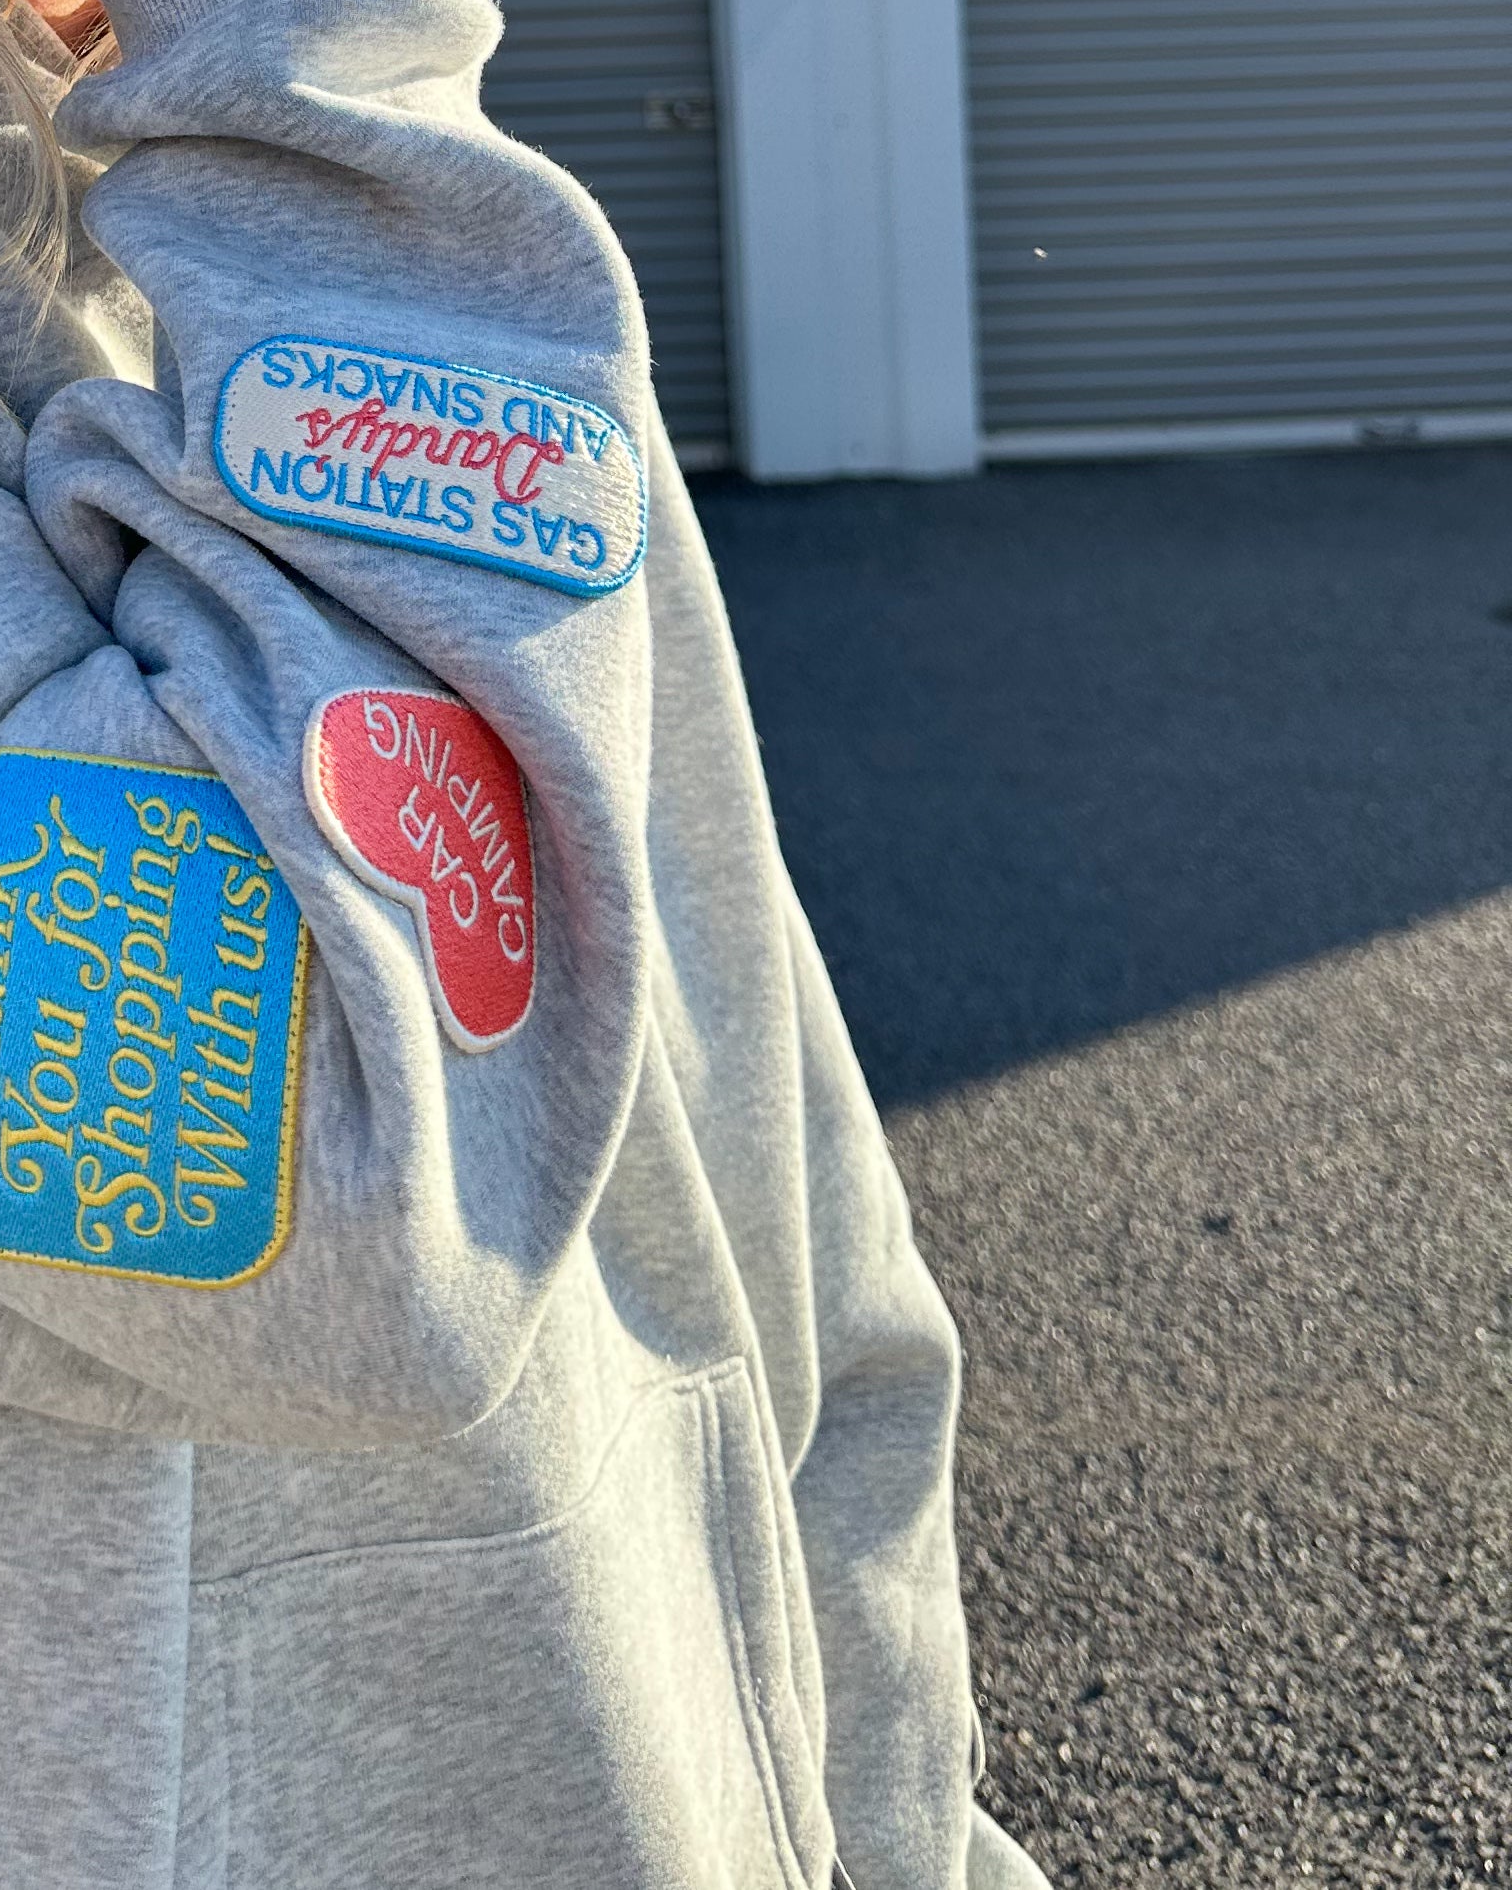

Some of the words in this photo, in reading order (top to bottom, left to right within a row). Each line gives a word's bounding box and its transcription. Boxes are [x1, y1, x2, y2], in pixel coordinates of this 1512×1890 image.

[262, 347, 486, 426] SNACKS
[296, 399, 564, 504] Dandy's
[502, 397, 615, 461] AND
[250, 448, 476, 533] STATION
[493, 500, 606, 570] GAS
[25, 794, 112, 991] for
[363, 696, 527, 963] CAMPING
[398, 785, 480, 928] CAR
[206, 832, 277, 971] us!
[74, 789, 202, 1254] Shopping
[0, 997, 87, 1194] You
[174, 991, 262, 1228] With
